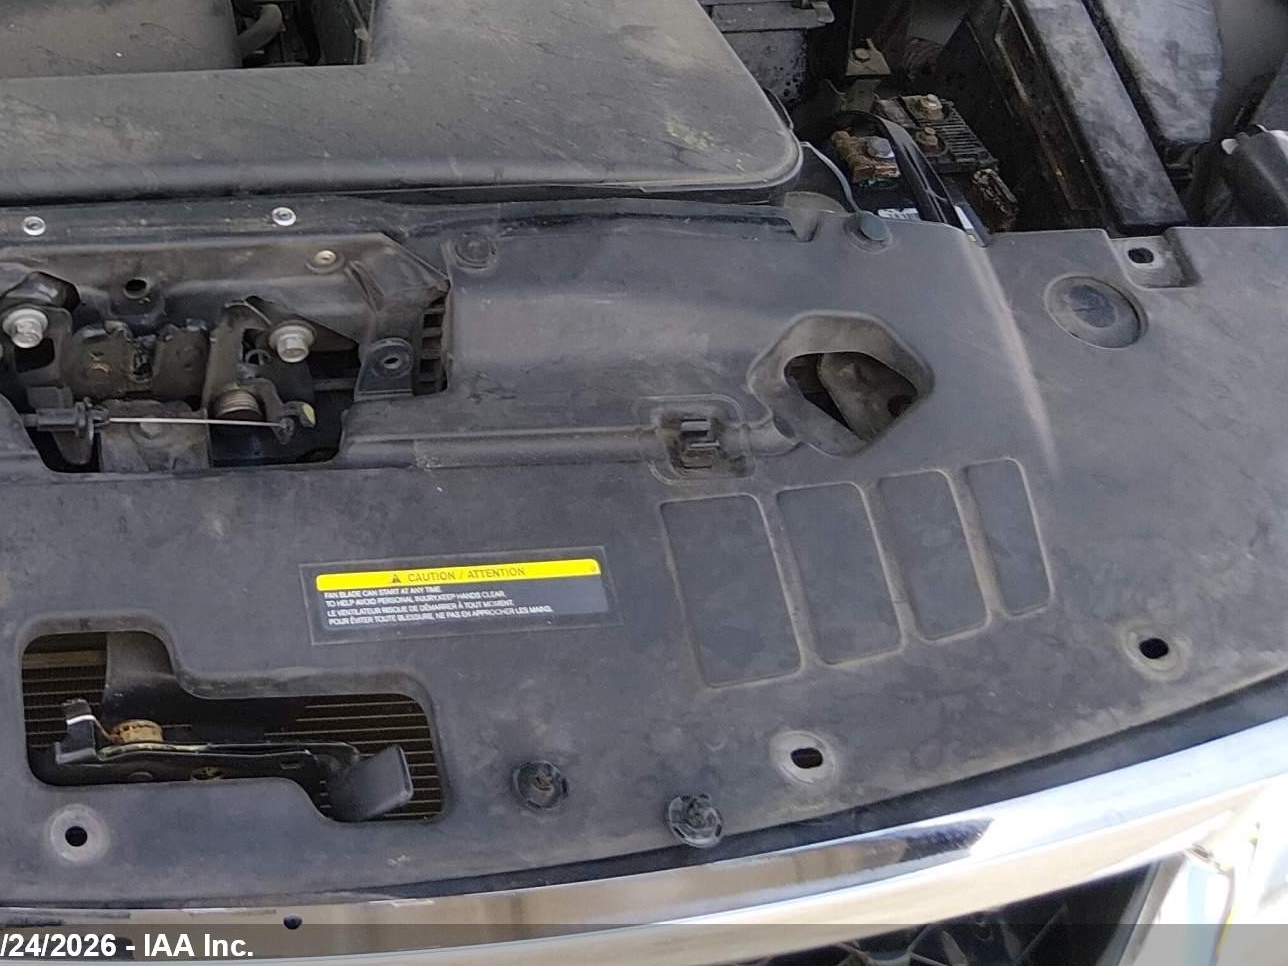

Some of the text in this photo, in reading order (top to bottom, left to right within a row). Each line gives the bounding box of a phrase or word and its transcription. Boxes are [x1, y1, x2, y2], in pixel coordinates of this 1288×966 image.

[407, 571, 456, 583] CAUTION
[467, 567, 526, 579] ATTENTION
[326, 600, 336, 608] TO
[337, 599, 354, 607] HELP
[355, 598, 377, 606] AVOID
[377, 596, 414, 605] PERSONAL
[456, 591, 481, 600] HANDS
[362, 589, 378, 597] CAN
[378, 588, 399, 596] START
[400, 587, 409, 595] AT
[410, 586, 425, 594] ANY
[327, 610, 336, 618] LE
[337, 607, 381, 617] VENTILATEUR
[382, 605, 408, 614] RISQUE
[420, 601, 457, 612] DÉMARRER
[464, 600, 482, 609] TOUT
[329, 617, 349, 625] POUR
[350, 614, 374, 624] ÉVITER
[374, 614, 397, 623] TOUTE
[446, 611, 461, 619] PAS
[462, 610, 472, 618] EN
[472, 607, 515, 617] APPROCHER
[515, 606, 528, 614] LES
